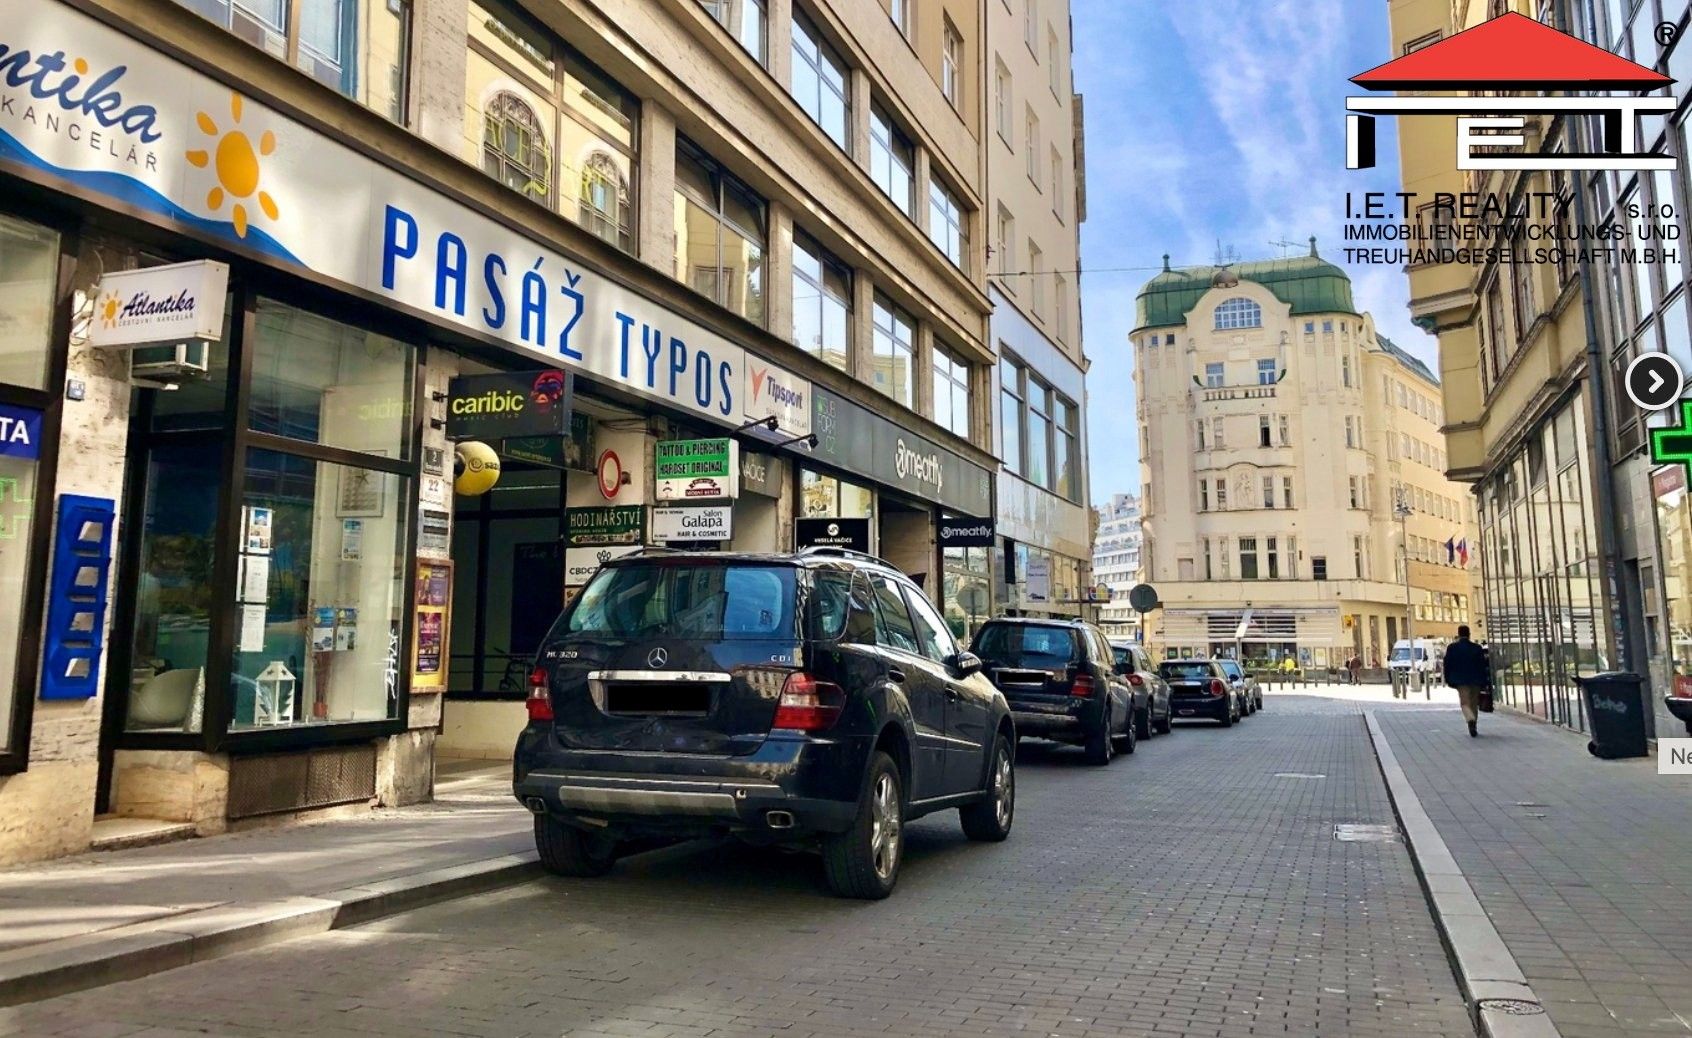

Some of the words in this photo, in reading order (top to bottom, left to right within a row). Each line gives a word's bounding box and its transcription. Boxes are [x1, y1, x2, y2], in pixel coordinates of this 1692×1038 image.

[1, 94, 157, 172] KANCELÁŘ
[119, 288, 195, 320] Atlantika
[382, 204, 585, 361] PASÁŽ
[615, 311, 732, 416] TYPOS
[452, 390, 524, 415] caribic
[767, 375, 802, 410] Tipsport
[0, 416, 30, 445] TA
[428, 480, 439, 492] 22
[570, 507, 641, 528] HODINÁŘSTVÍ
[682, 515, 723, 528] Galapa
[703, 509, 723, 518] Salon
[559, 651, 578, 659] 320
[770, 654, 791, 662] CDI
